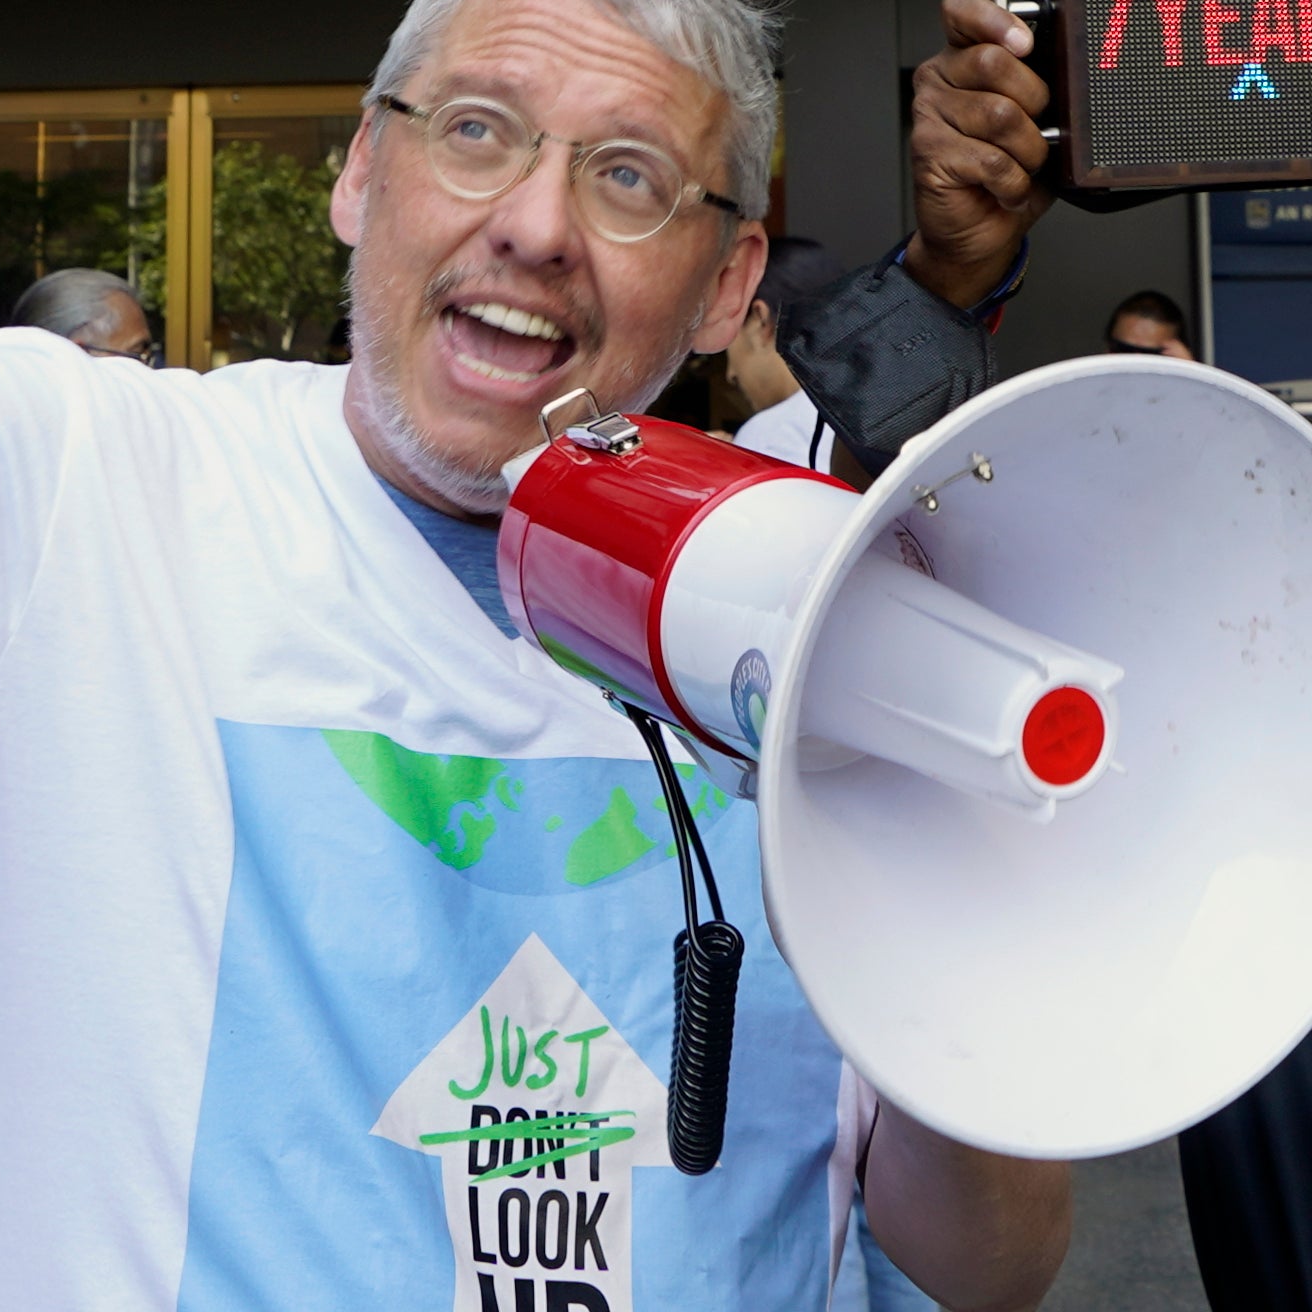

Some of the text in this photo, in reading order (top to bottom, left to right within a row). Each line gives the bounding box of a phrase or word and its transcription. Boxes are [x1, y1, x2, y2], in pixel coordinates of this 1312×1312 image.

[448, 1004, 610, 1101] JUST
[468, 1104, 610, 1182] DON'T
[468, 1185, 611, 1271] LOOK
